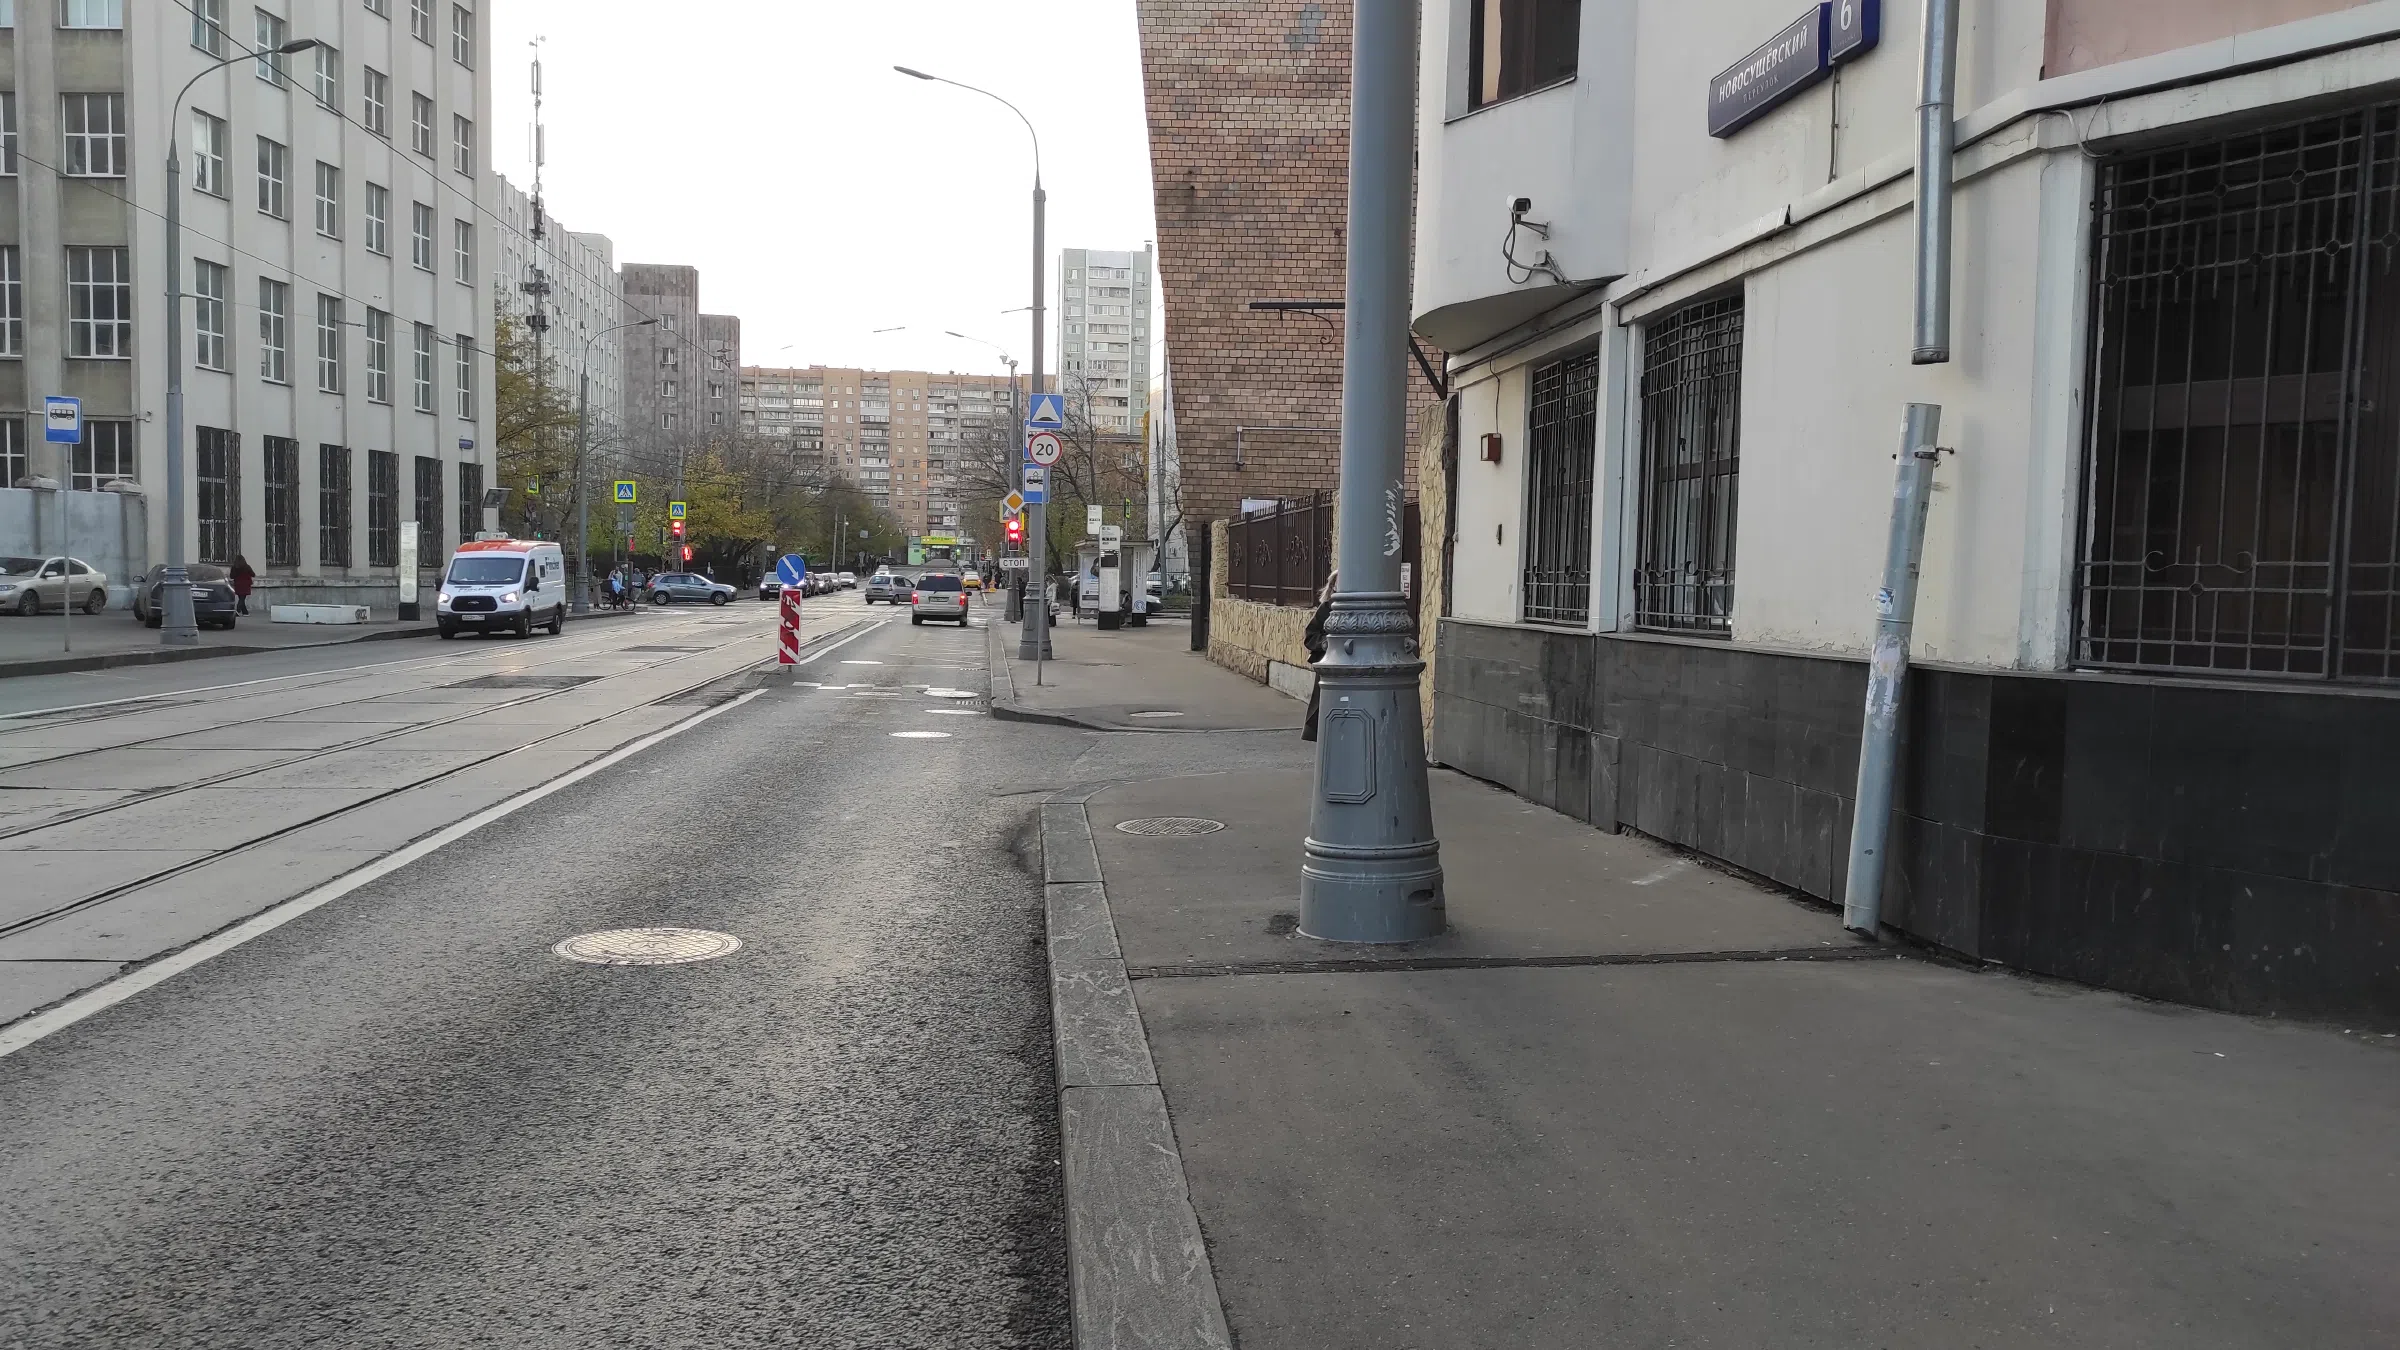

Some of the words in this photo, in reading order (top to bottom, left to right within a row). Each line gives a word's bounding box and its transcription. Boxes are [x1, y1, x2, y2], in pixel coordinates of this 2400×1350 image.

[1840, 0, 1852, 31] 6
[1718, 24, 1808, 103] НОВОСУЩЁВСКИЙ
[1743, 75, 1779, 103] ПЕРЕУЛОК
[1035, 443, 1054, 456] 20
[1002, 559, 1025, 567] СТОП
